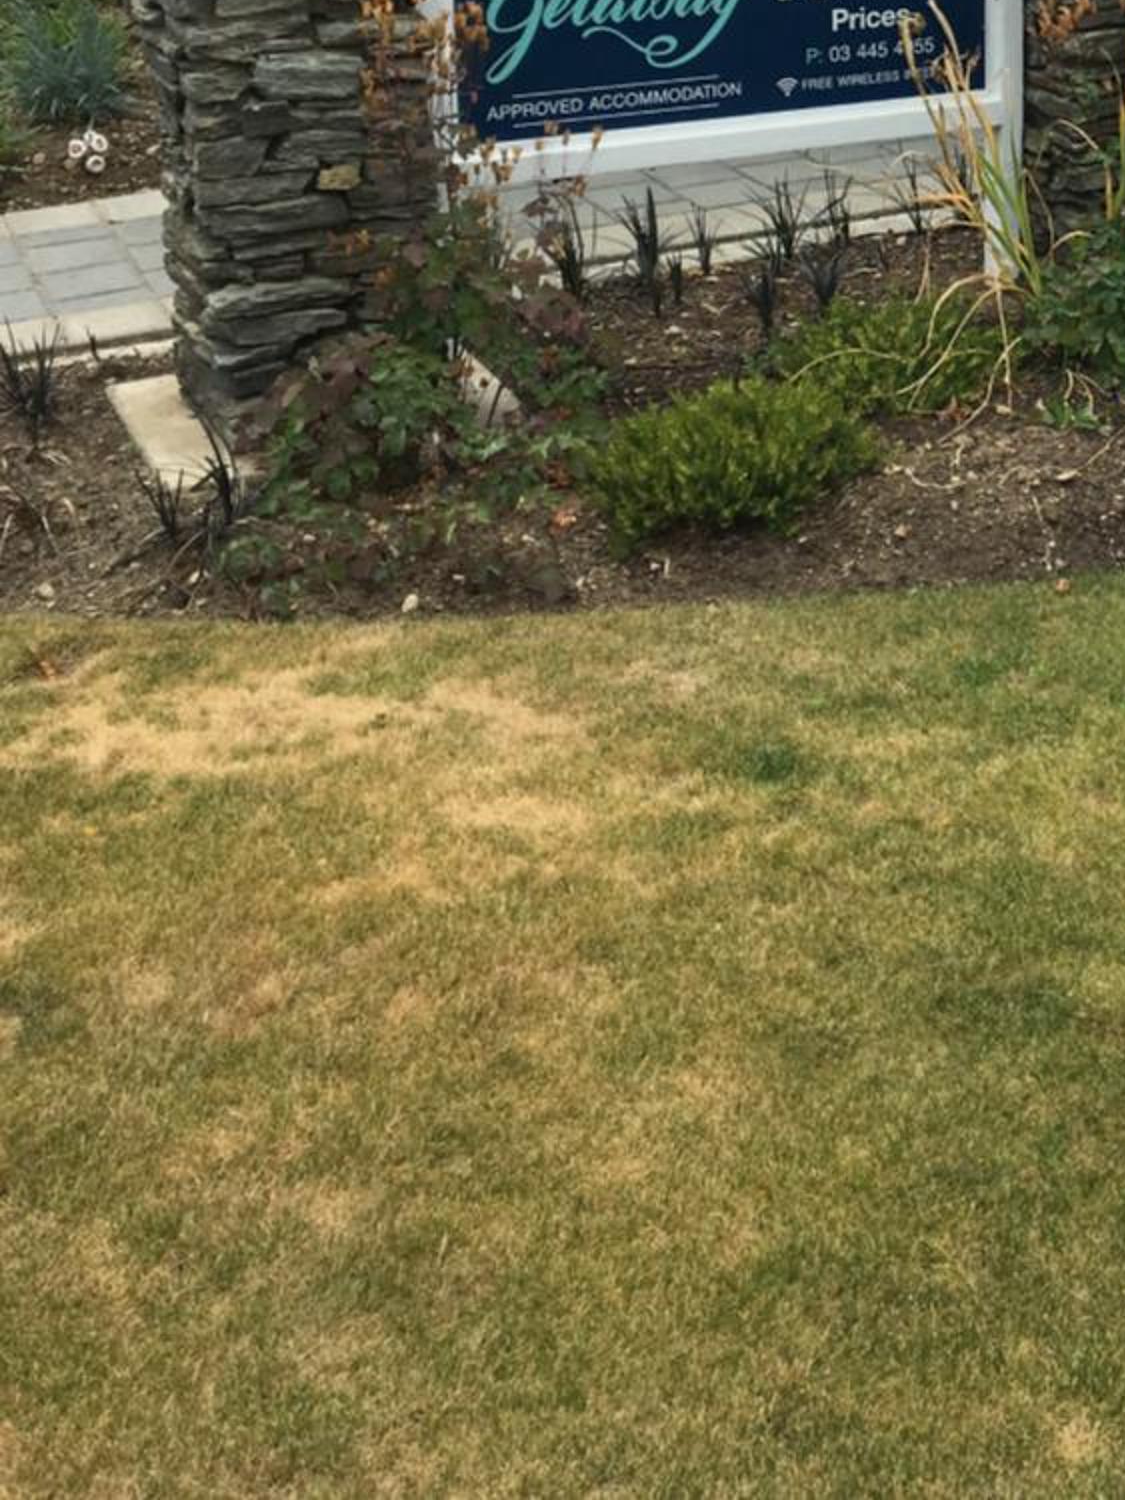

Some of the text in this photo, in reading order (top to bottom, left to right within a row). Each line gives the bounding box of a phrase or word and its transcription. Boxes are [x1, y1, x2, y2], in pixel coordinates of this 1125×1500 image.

[828, 45, 851, 63] 03
[856, 41, 889, 58] 445
[893, 36, 935, 55] 455
[801, 76, 833, 90] FREE
[837, 70, 900, 87] WIRELESS
[486, 81, 743, 122] APPROVED ACCOMMODATION
